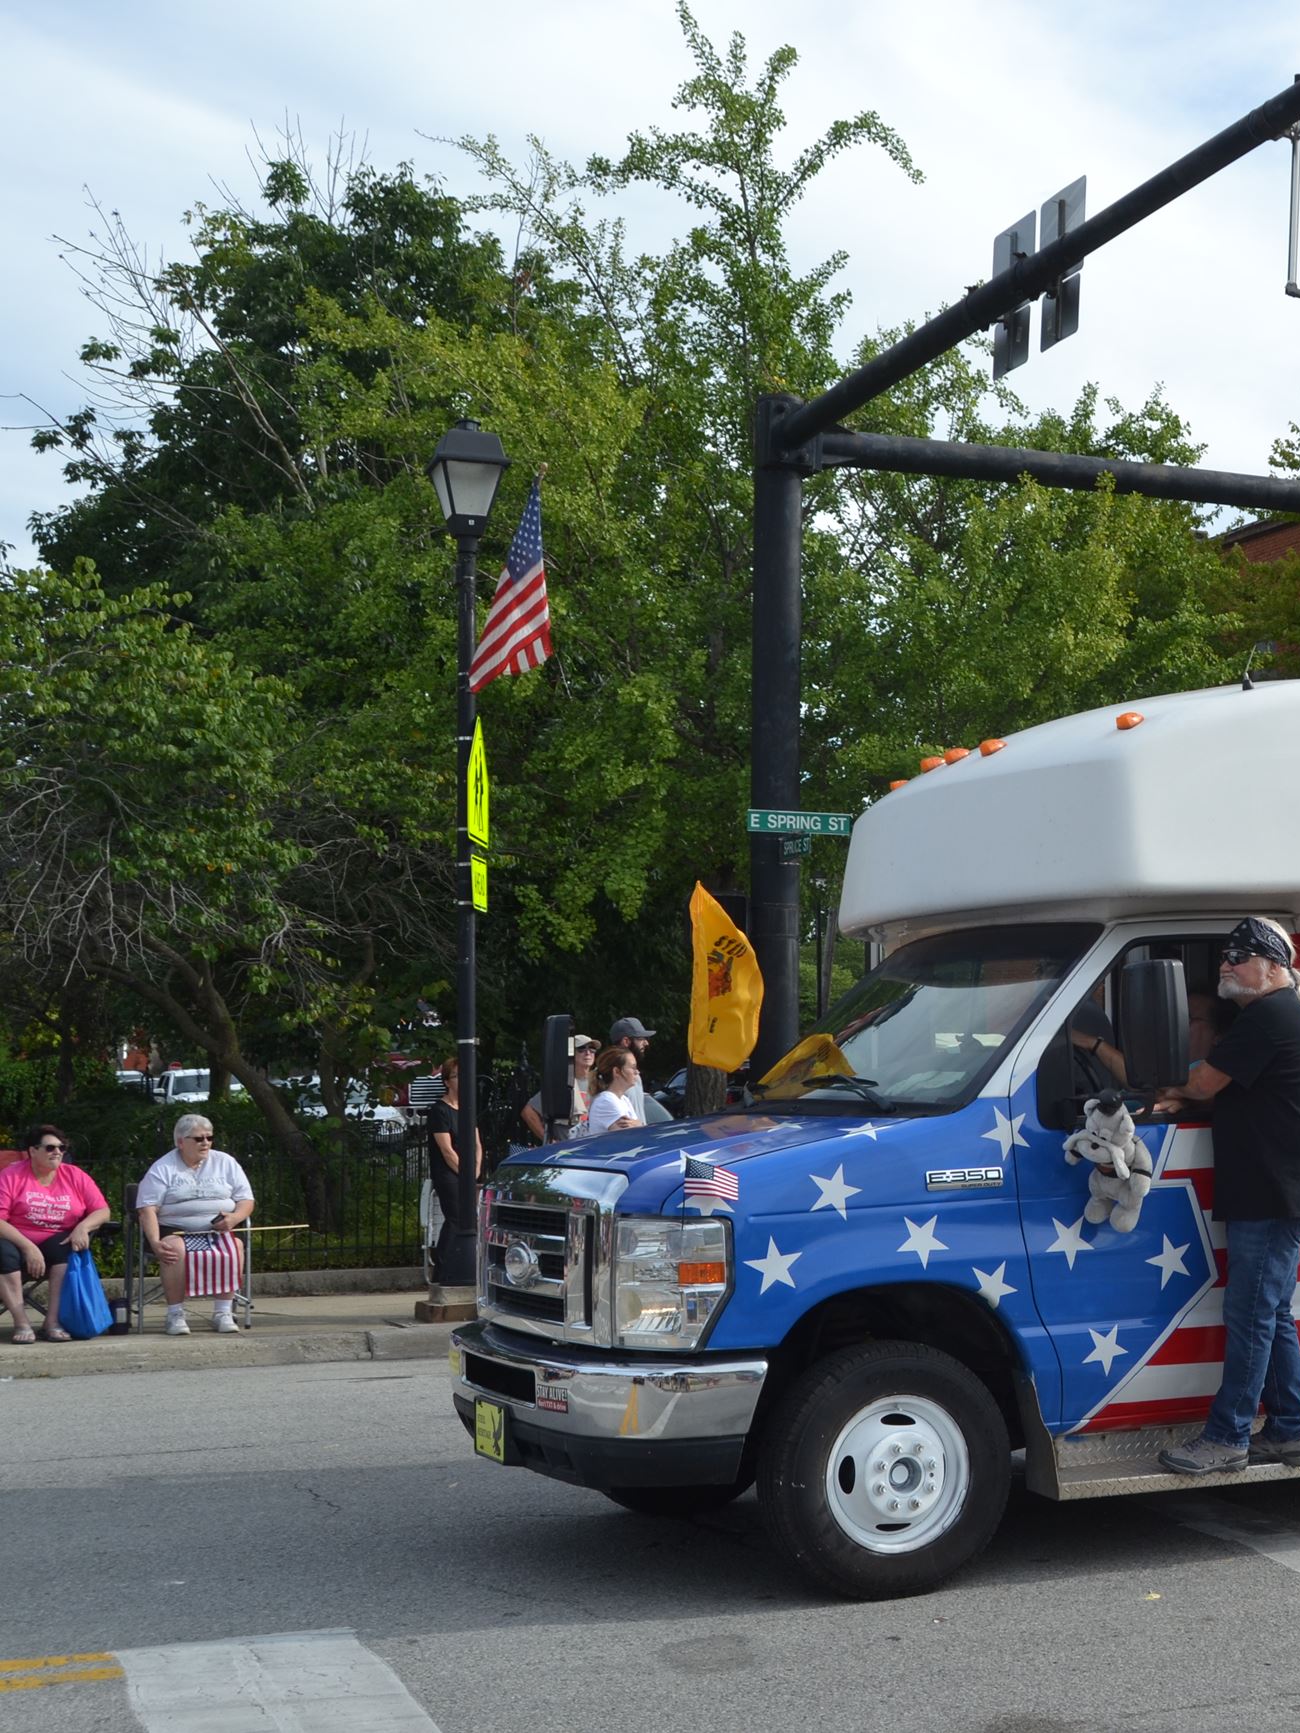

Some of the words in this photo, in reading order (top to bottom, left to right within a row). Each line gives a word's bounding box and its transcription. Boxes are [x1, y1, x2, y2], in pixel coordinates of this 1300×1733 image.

[750, 814, 760, 828] E
[767, 815, 821, 830] SPRING
[828, 817, 847, 831] ST
[783, 840, 802, 856] SPRUCE
[802, 837, 810, 852] ST
[537, 1385, 549, 1399] STAY
